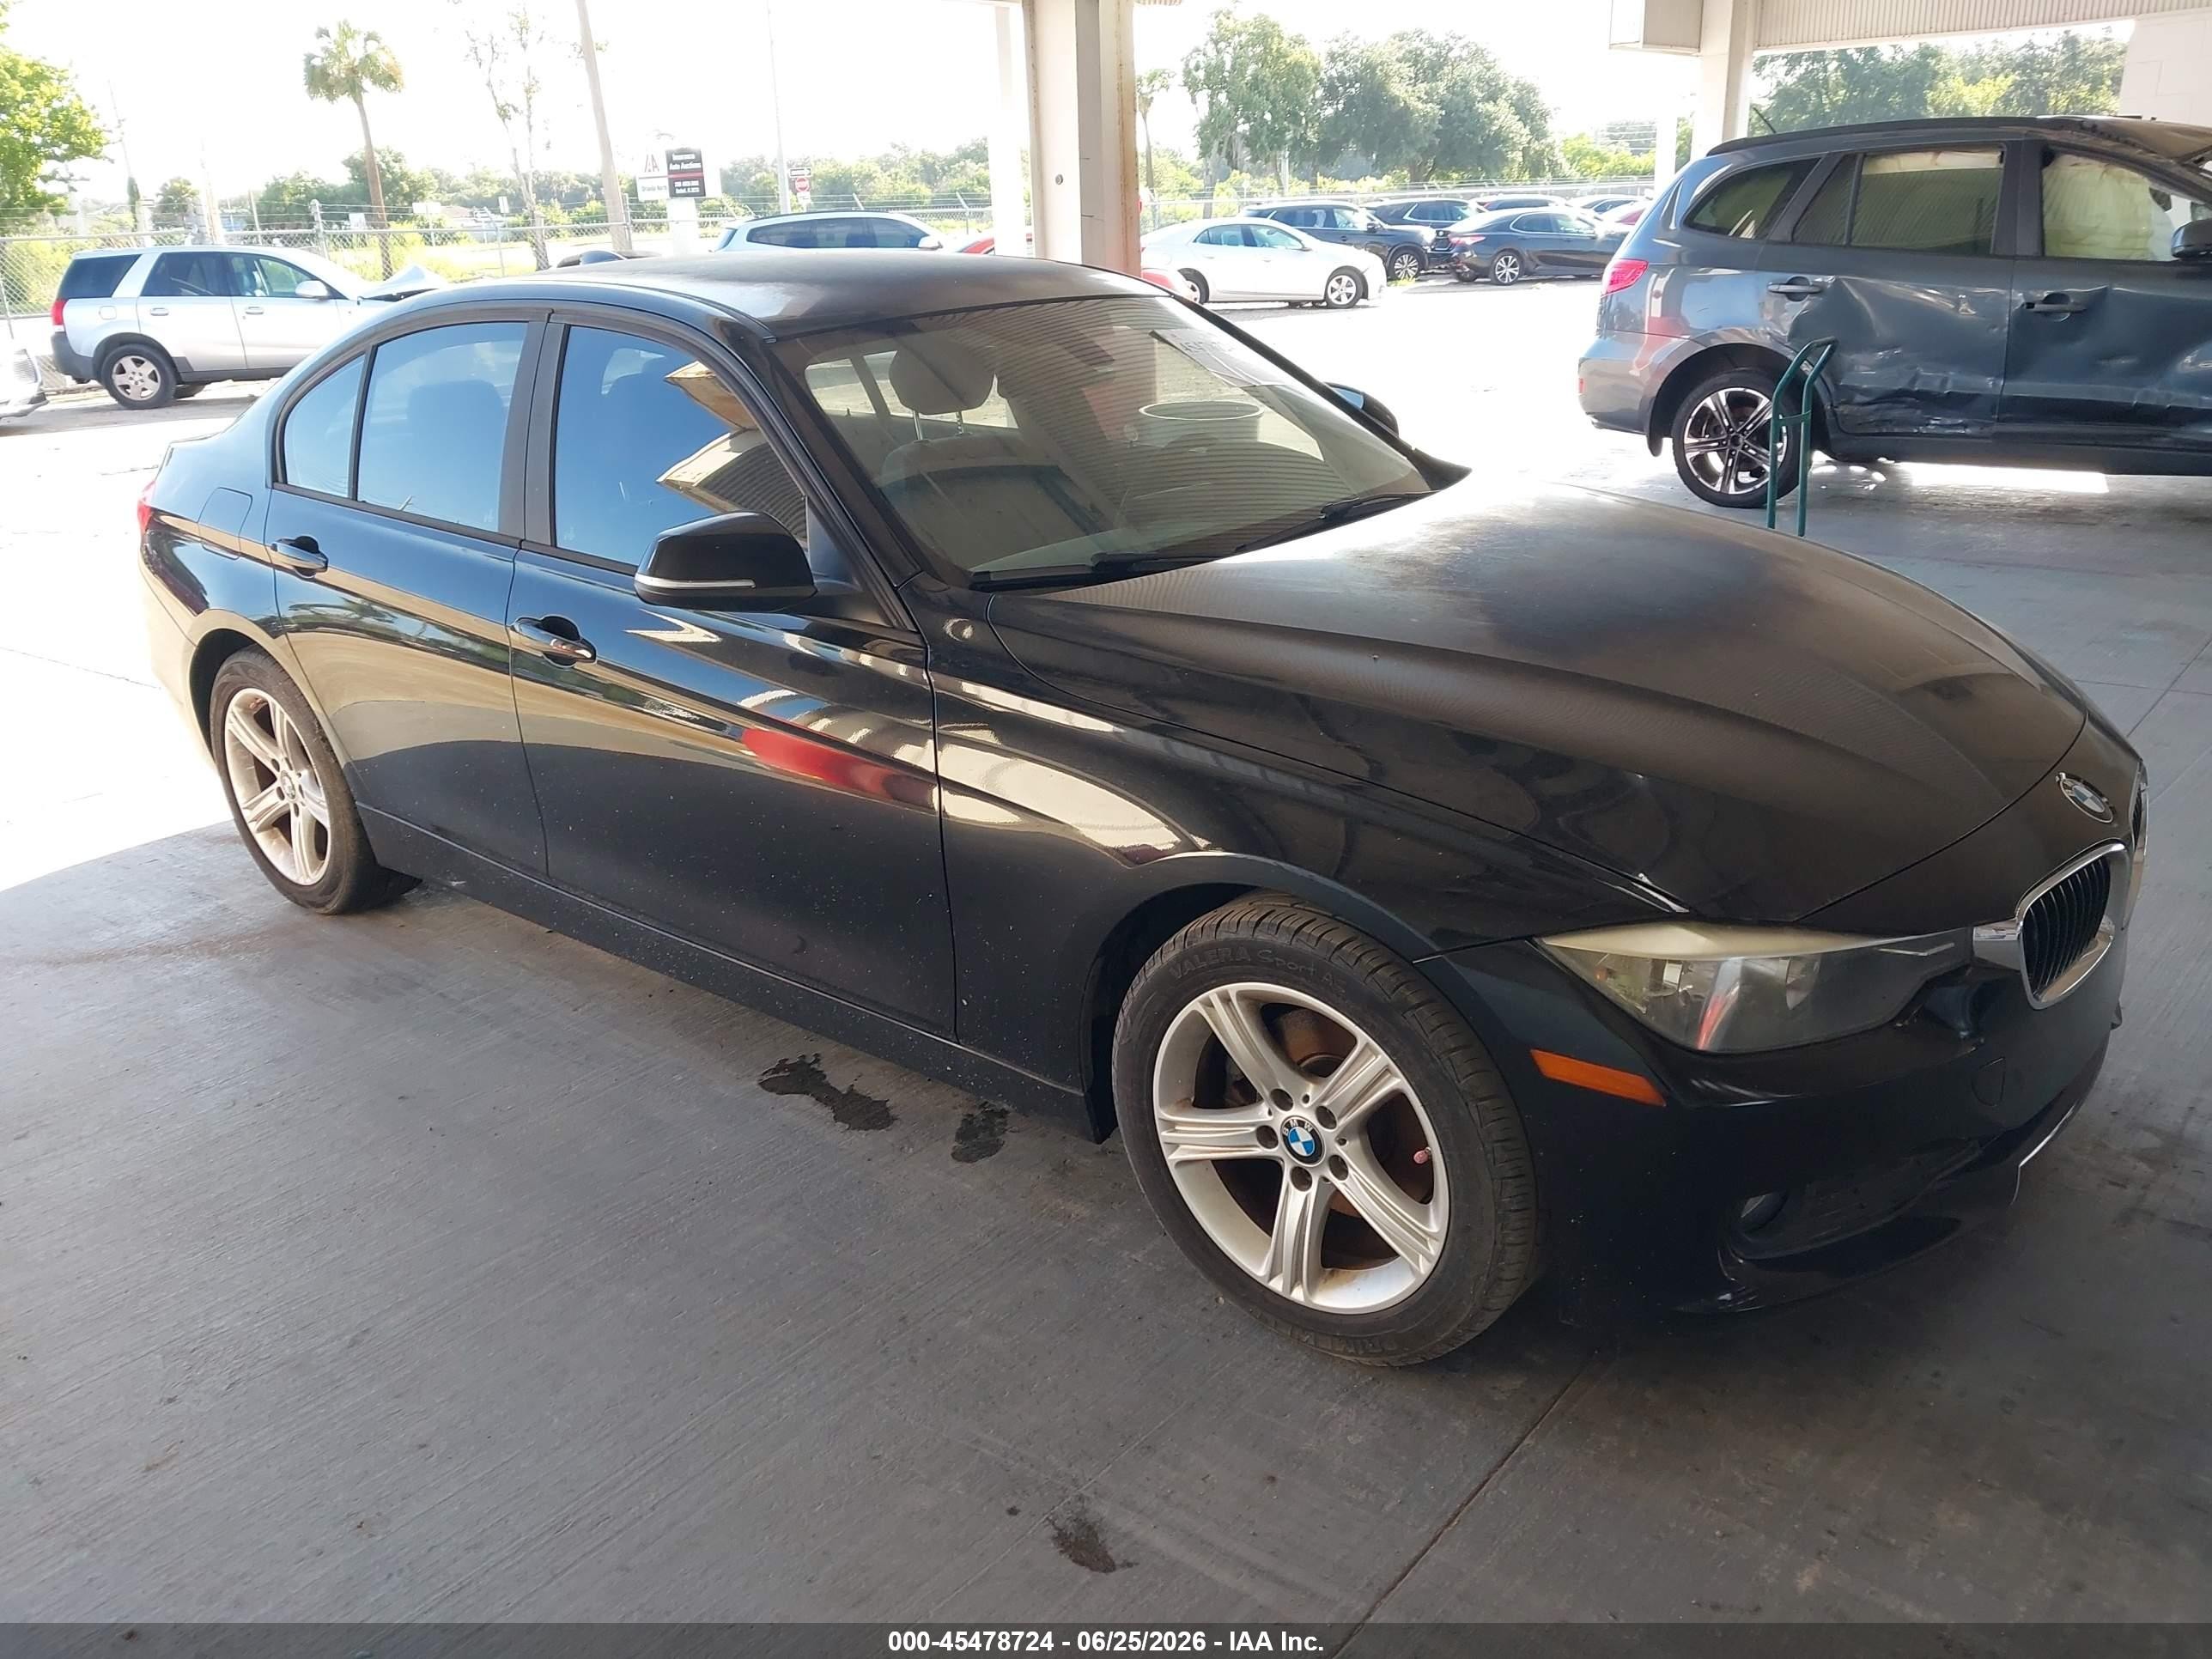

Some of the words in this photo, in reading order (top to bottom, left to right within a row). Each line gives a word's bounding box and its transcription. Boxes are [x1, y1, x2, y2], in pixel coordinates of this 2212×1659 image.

[1169, 947, 1251, 979] VALERA
[1257, 950, 1316, 976] Sport
[1282, 1119, 1314, 1136] BMW
